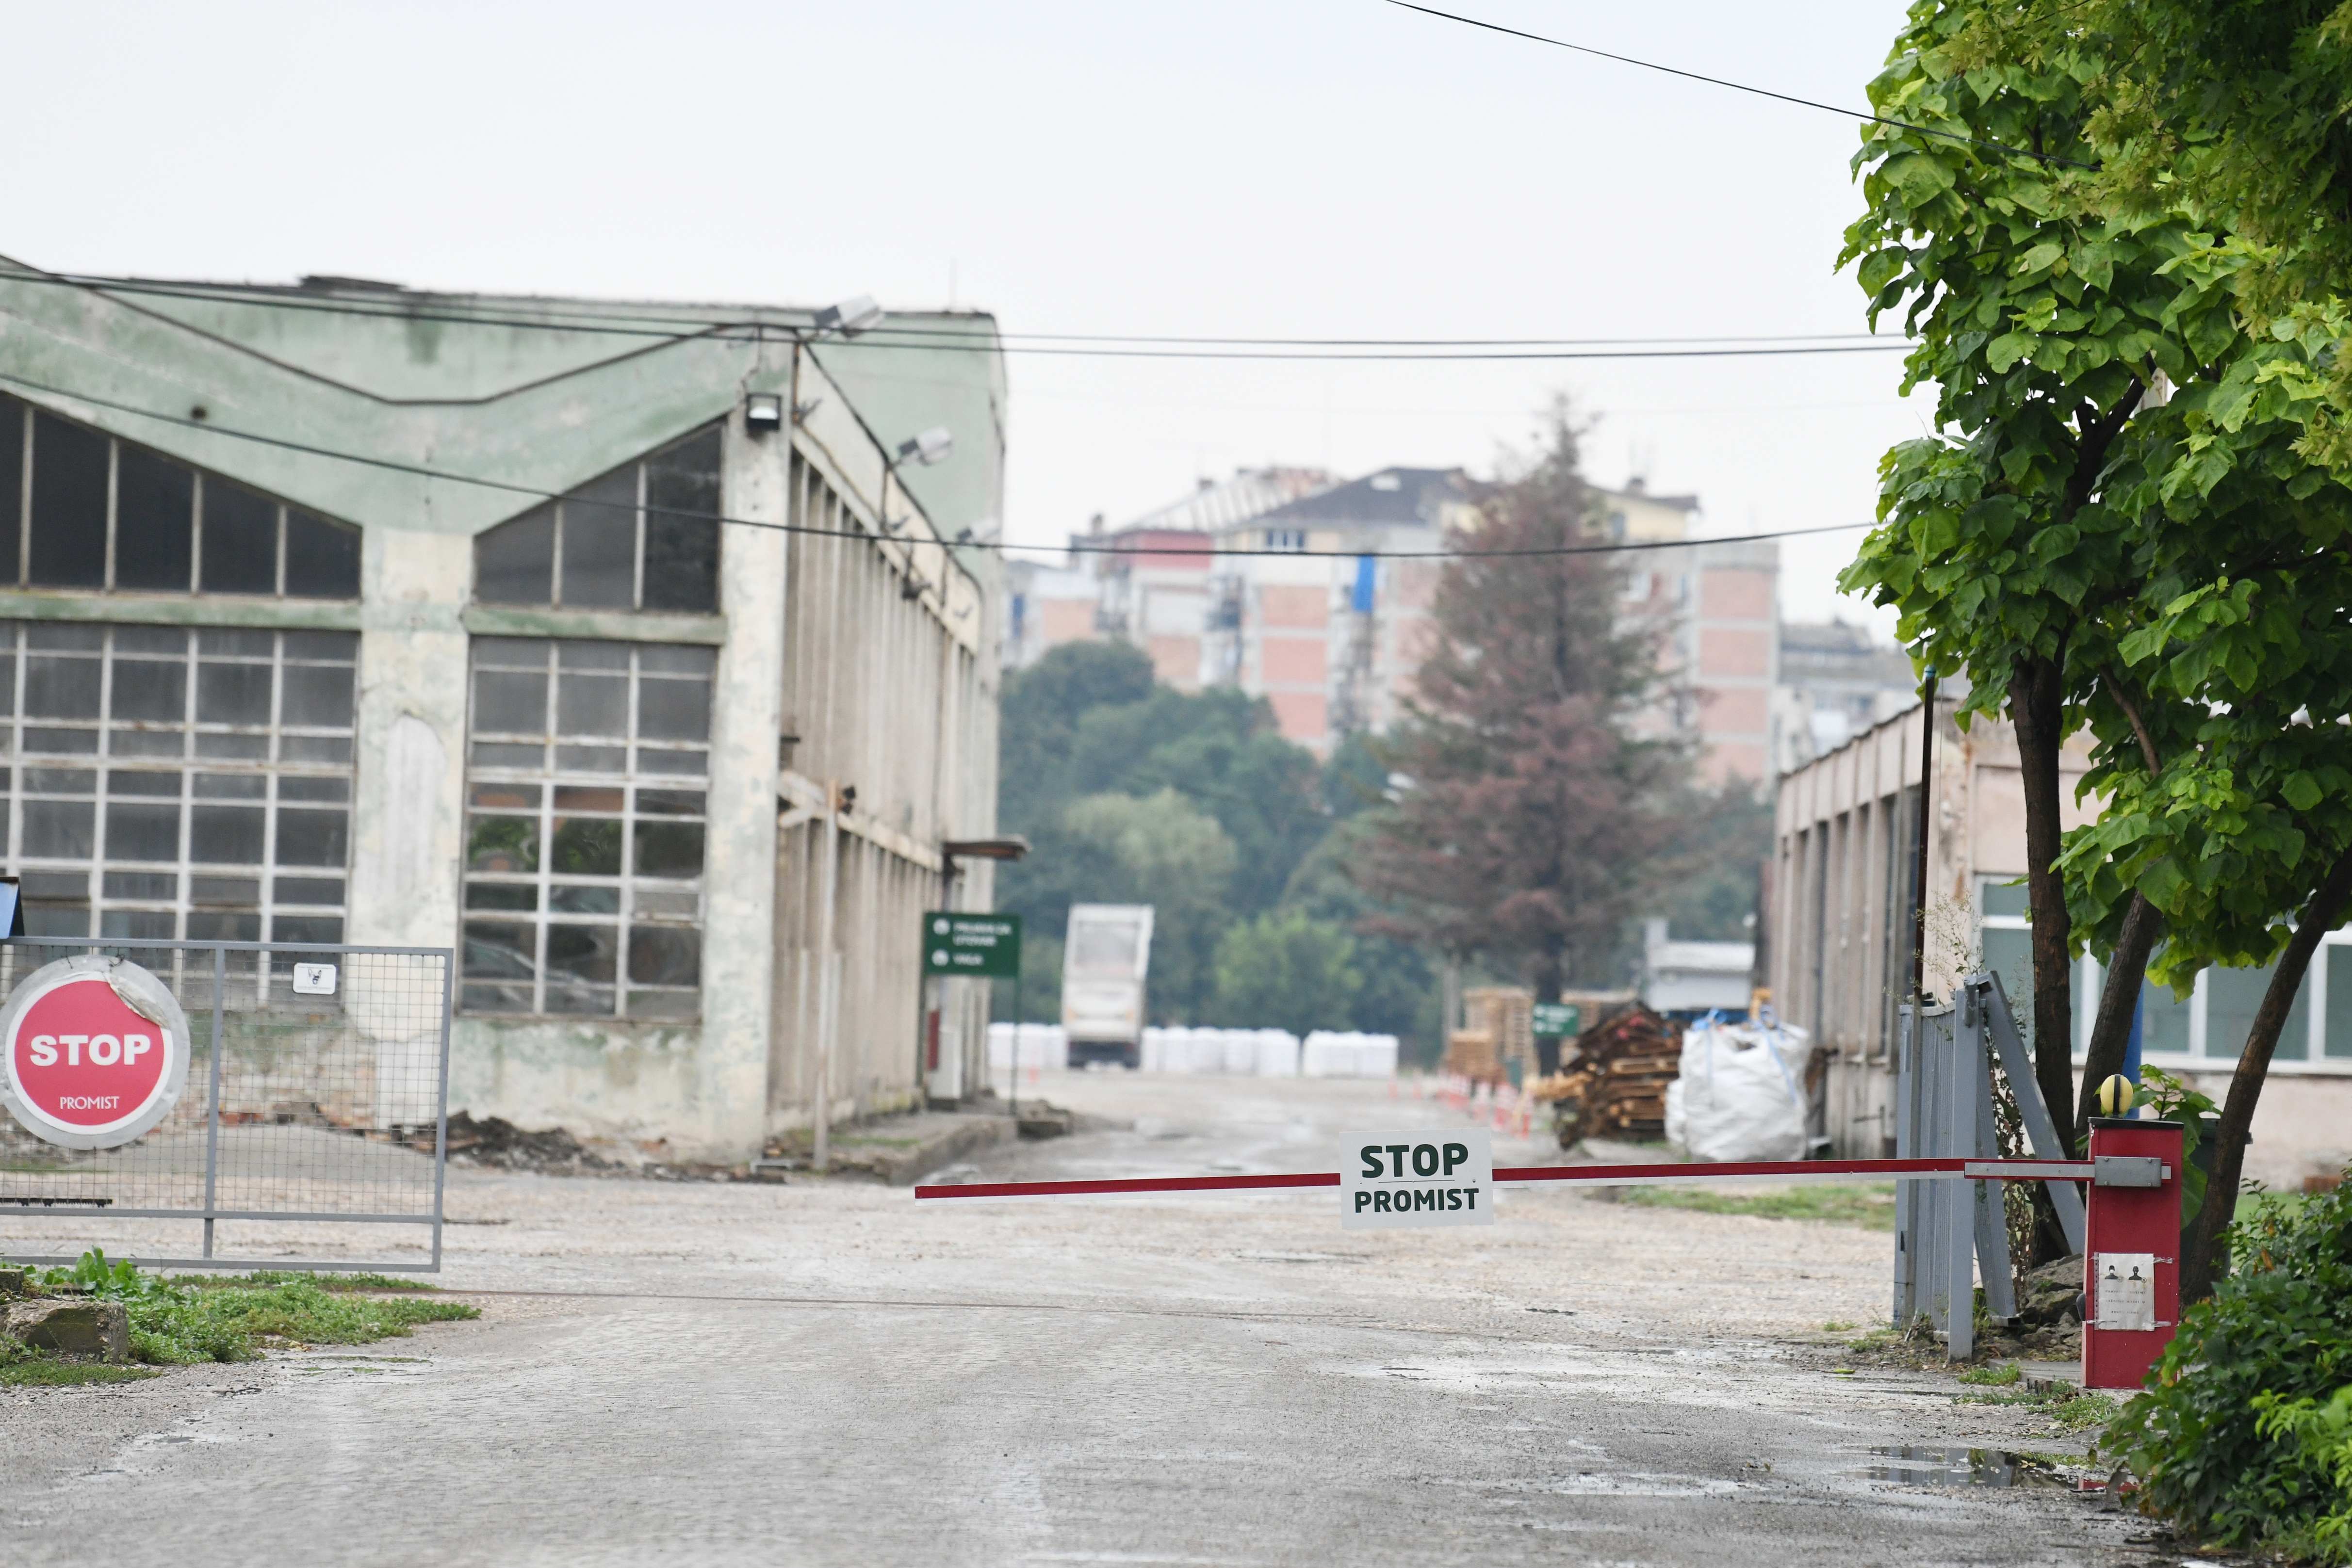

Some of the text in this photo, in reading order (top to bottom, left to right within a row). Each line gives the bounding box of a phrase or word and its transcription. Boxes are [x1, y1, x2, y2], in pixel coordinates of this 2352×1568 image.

[30, 1034, 151, 1067] STOP
[60, 1096, 119, 1110] PROMIST
[1360, 1143, 1469, 1179] STOP
[1355, 1188, 1479, 1213] PROMIST
